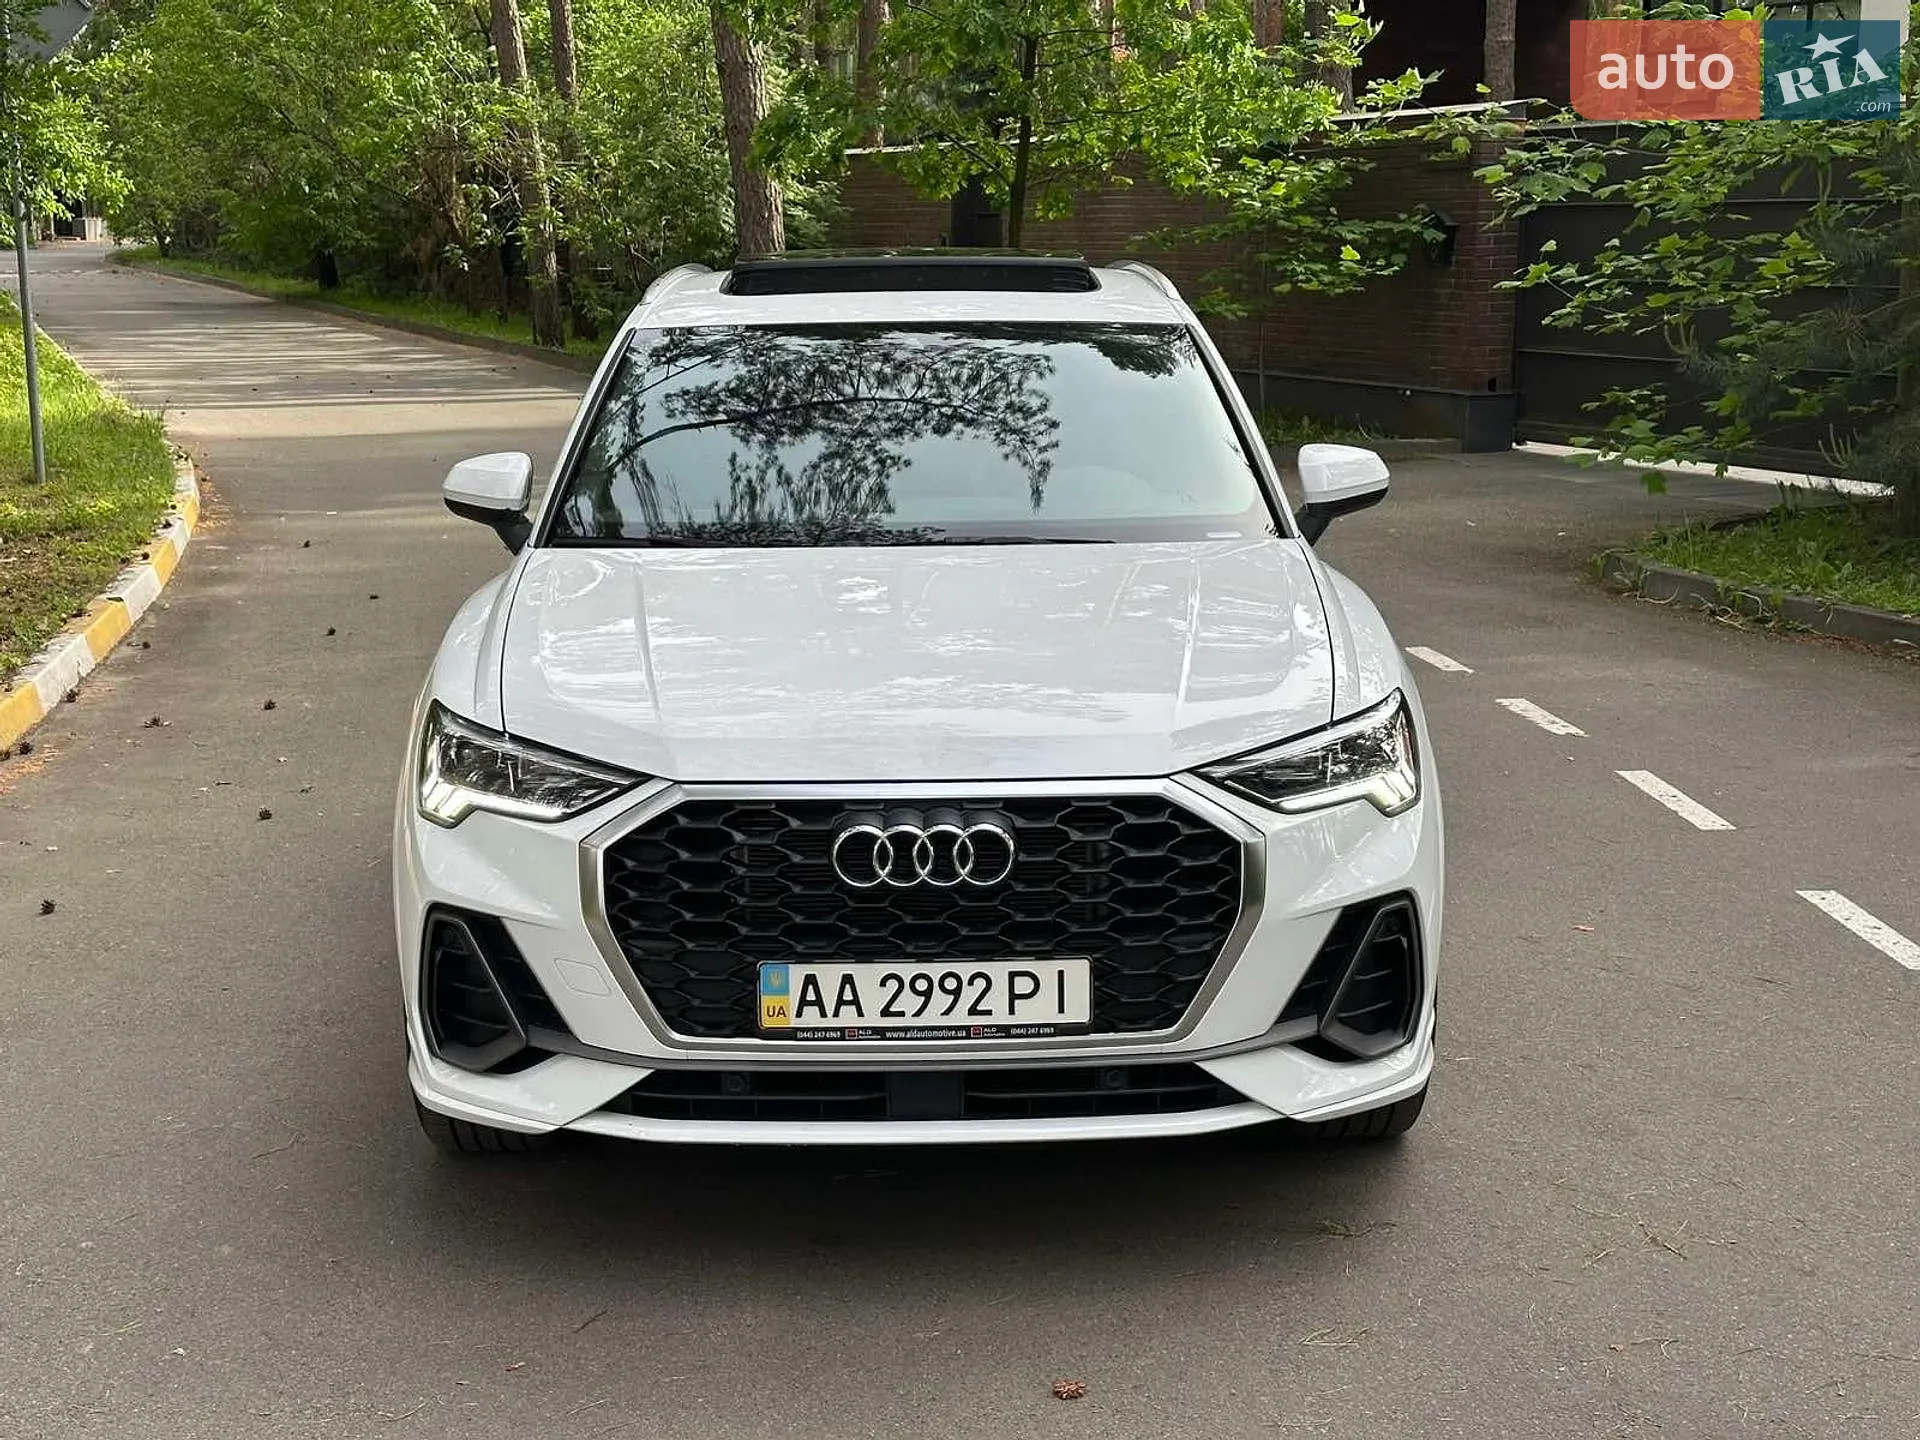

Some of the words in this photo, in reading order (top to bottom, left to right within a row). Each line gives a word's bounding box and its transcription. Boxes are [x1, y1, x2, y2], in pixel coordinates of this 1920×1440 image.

[795, 973, 865, 1019] AA
[879, 970, 993, 1018] 2992
[1008, 969, 1065, 1016] PI
[766, 1005, 787, 1018] UA
[885, 1027, 966, 1039] www.aldautomotive.ua
